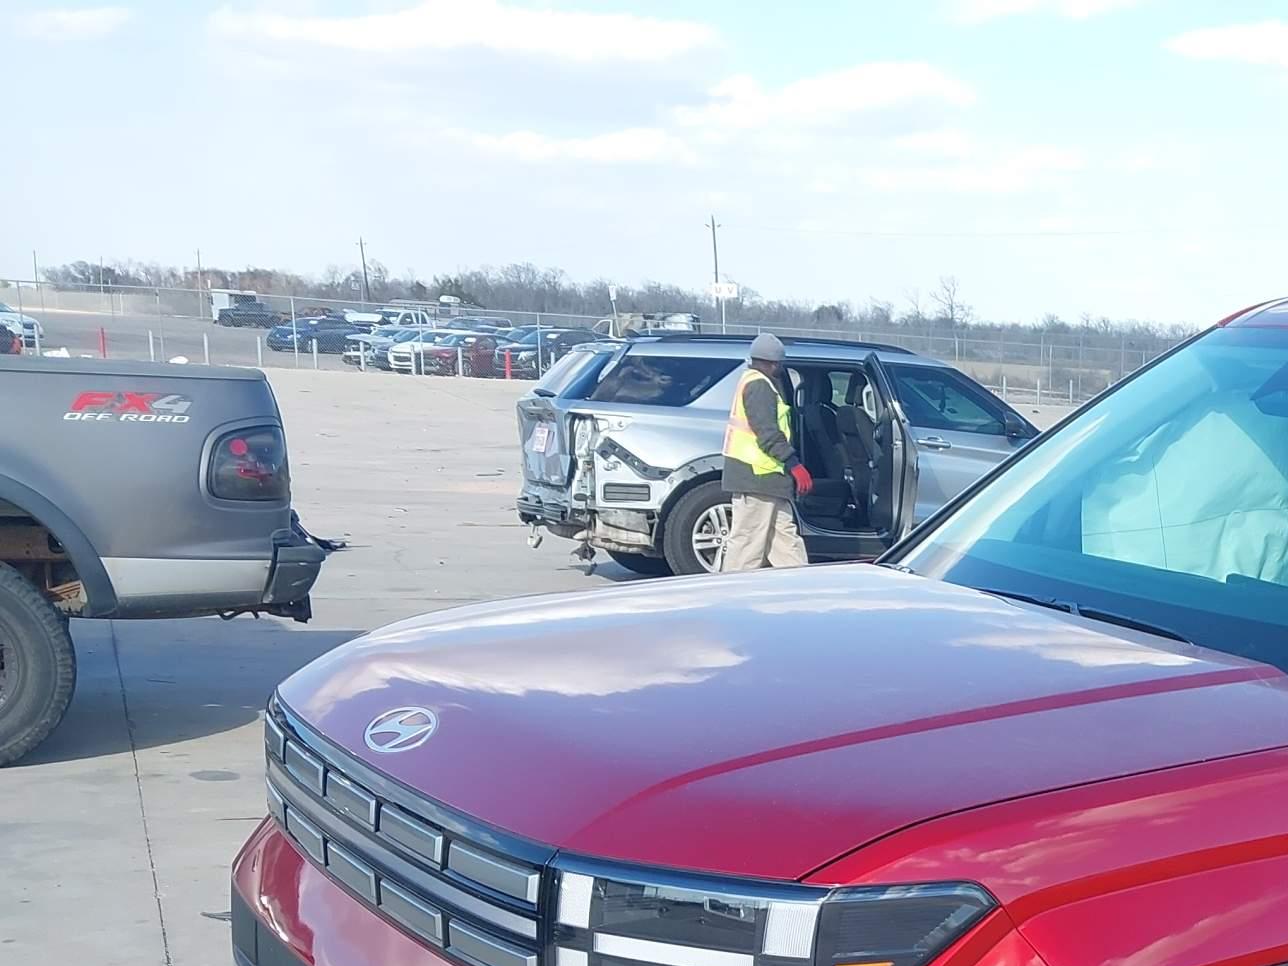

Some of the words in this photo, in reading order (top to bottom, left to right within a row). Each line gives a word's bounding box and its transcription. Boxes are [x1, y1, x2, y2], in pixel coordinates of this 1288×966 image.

[70, 390, 193, 414] FX4
[63, 412, 113, 421] OFF
[119, 413, 191, 423] ROAD
